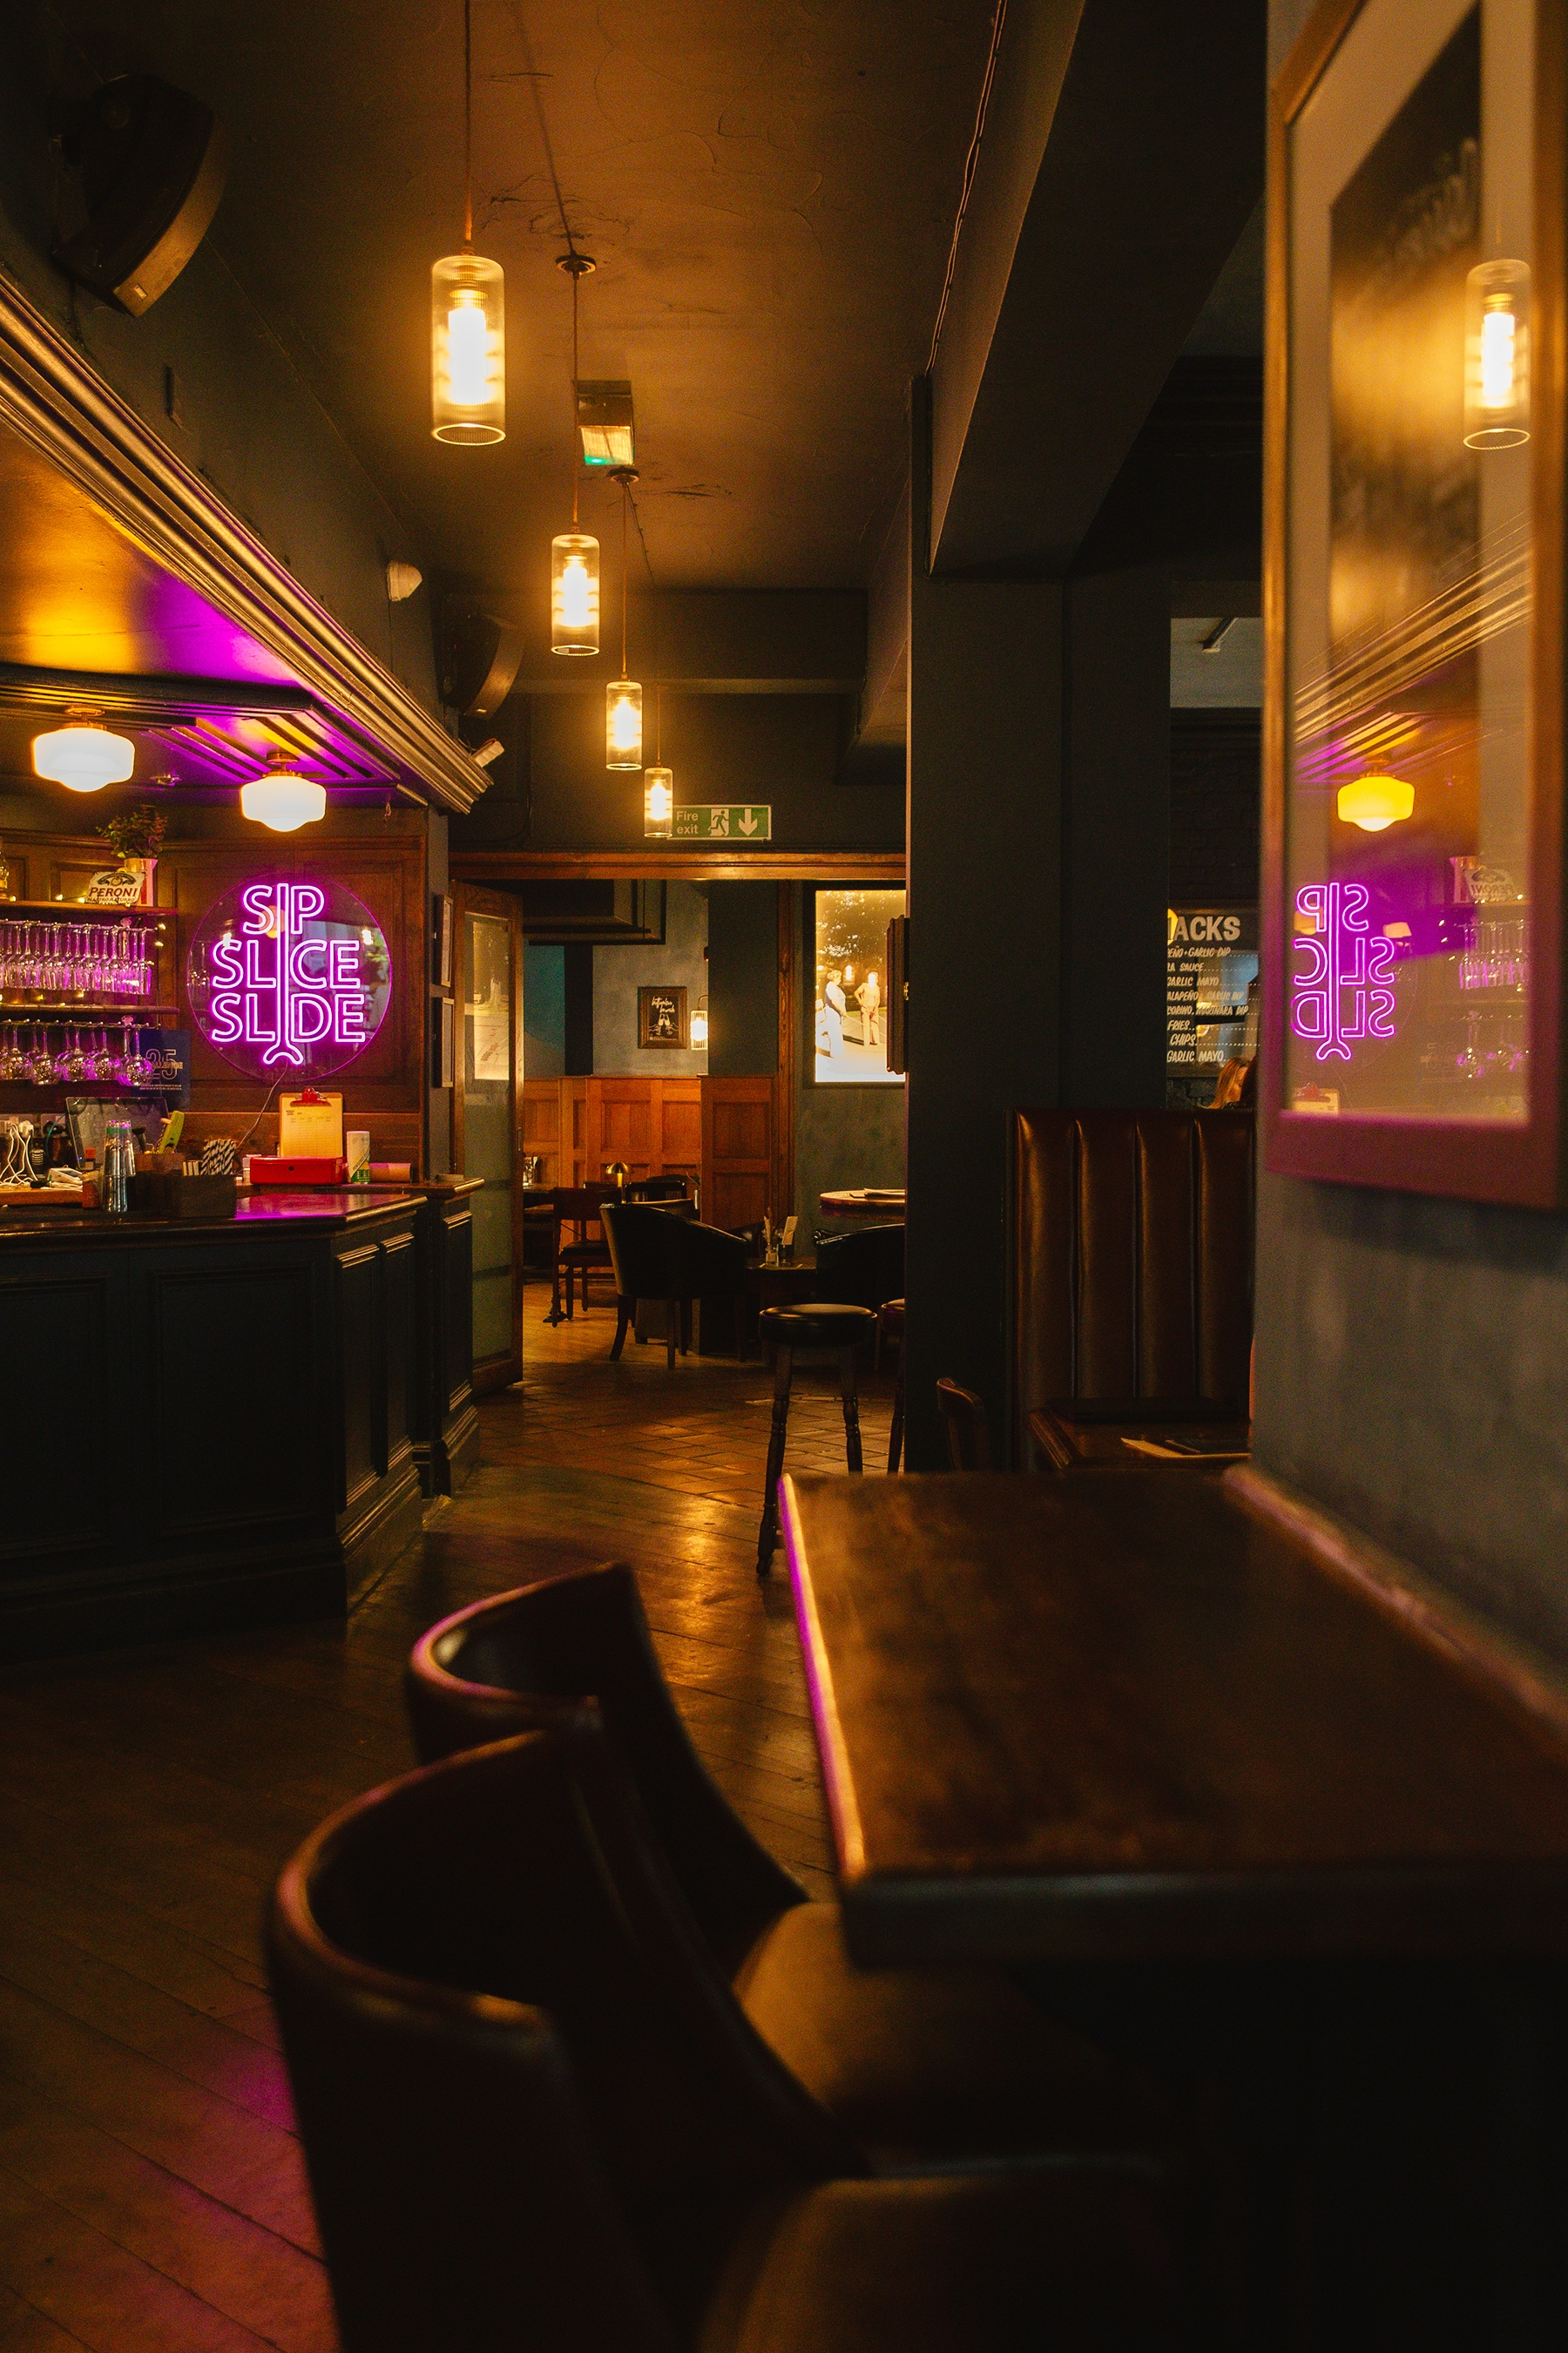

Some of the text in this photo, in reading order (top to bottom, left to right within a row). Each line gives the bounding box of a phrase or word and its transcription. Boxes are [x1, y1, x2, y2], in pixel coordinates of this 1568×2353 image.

[676, 810, 699, 822] Fire
[676, 823, 699, 835] exit
[88, 887, 138, 897] PERONI
[243, 882, 325, 935] SIP
[1168, 916, 1241, 941] ACKS
[1217, 947, 1232, 957] DIP
[212, 939, 361, 989] SLICE
[1179, 962, 1205, 972] SAUCE
[1196, 976, 1220, 987] MAYO
[1235, 1004, 1249, 1016] DIP
[211, 993, 366, 1043] SLIDE
[1167, 1019, 1191, 1031] FRIES
[1169, 1033, 1196, 1045] CHIPS
[1167, 1050, 1225, 1063] GARLIC MAYO
